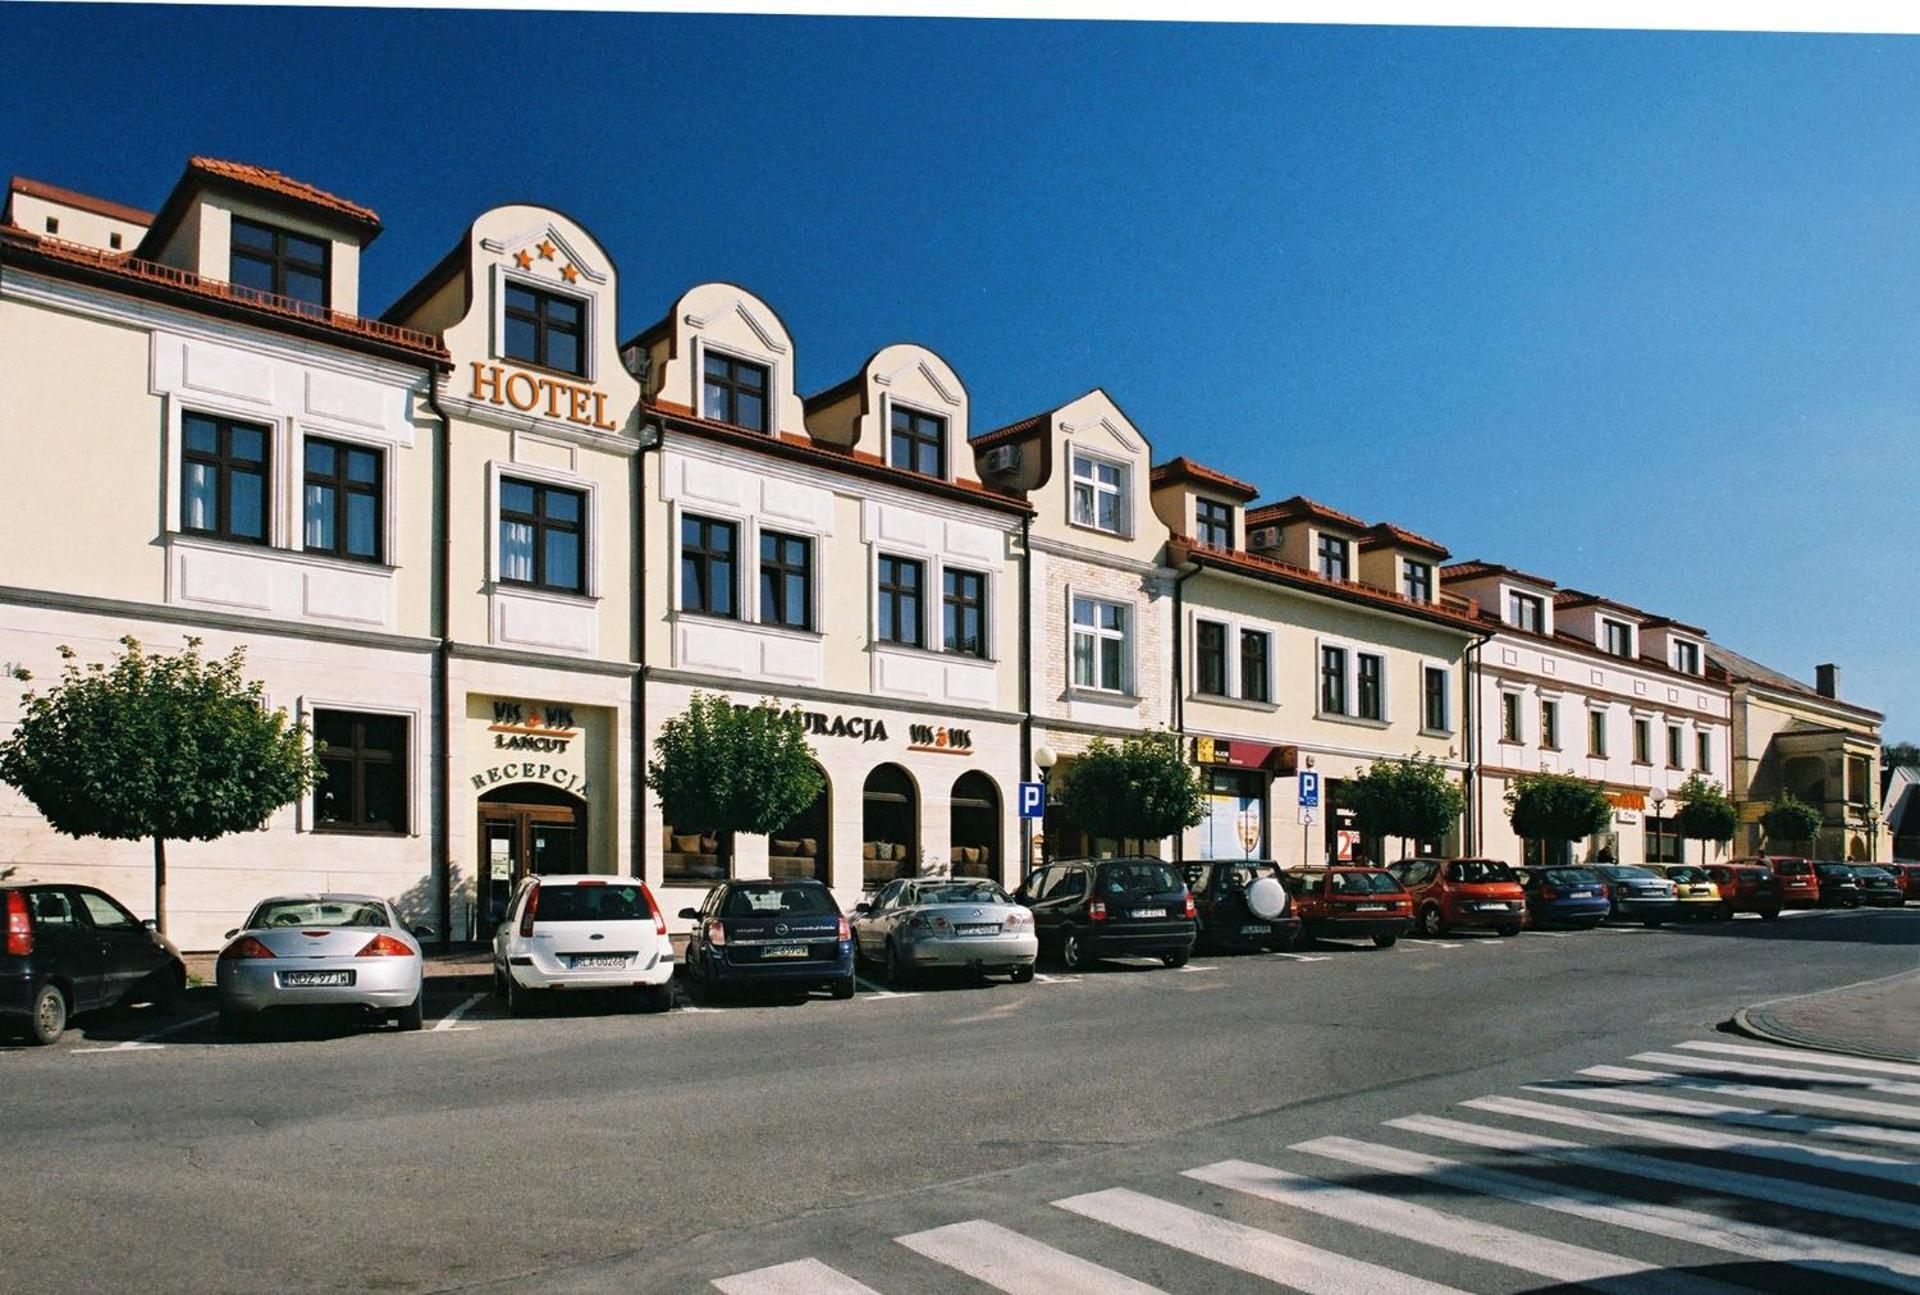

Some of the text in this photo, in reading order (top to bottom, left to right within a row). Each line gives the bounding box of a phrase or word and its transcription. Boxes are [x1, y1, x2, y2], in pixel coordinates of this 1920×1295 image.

[470, 361, 616, 431] HOTEL
[909, 724, 934, 746] VIS
[948, 728, 972, 750] VIS
[471, 762, 593, 796] RECEPCJA
[1303, 775, 1315, 797] P
[1025, 786, 1040, 814] P
